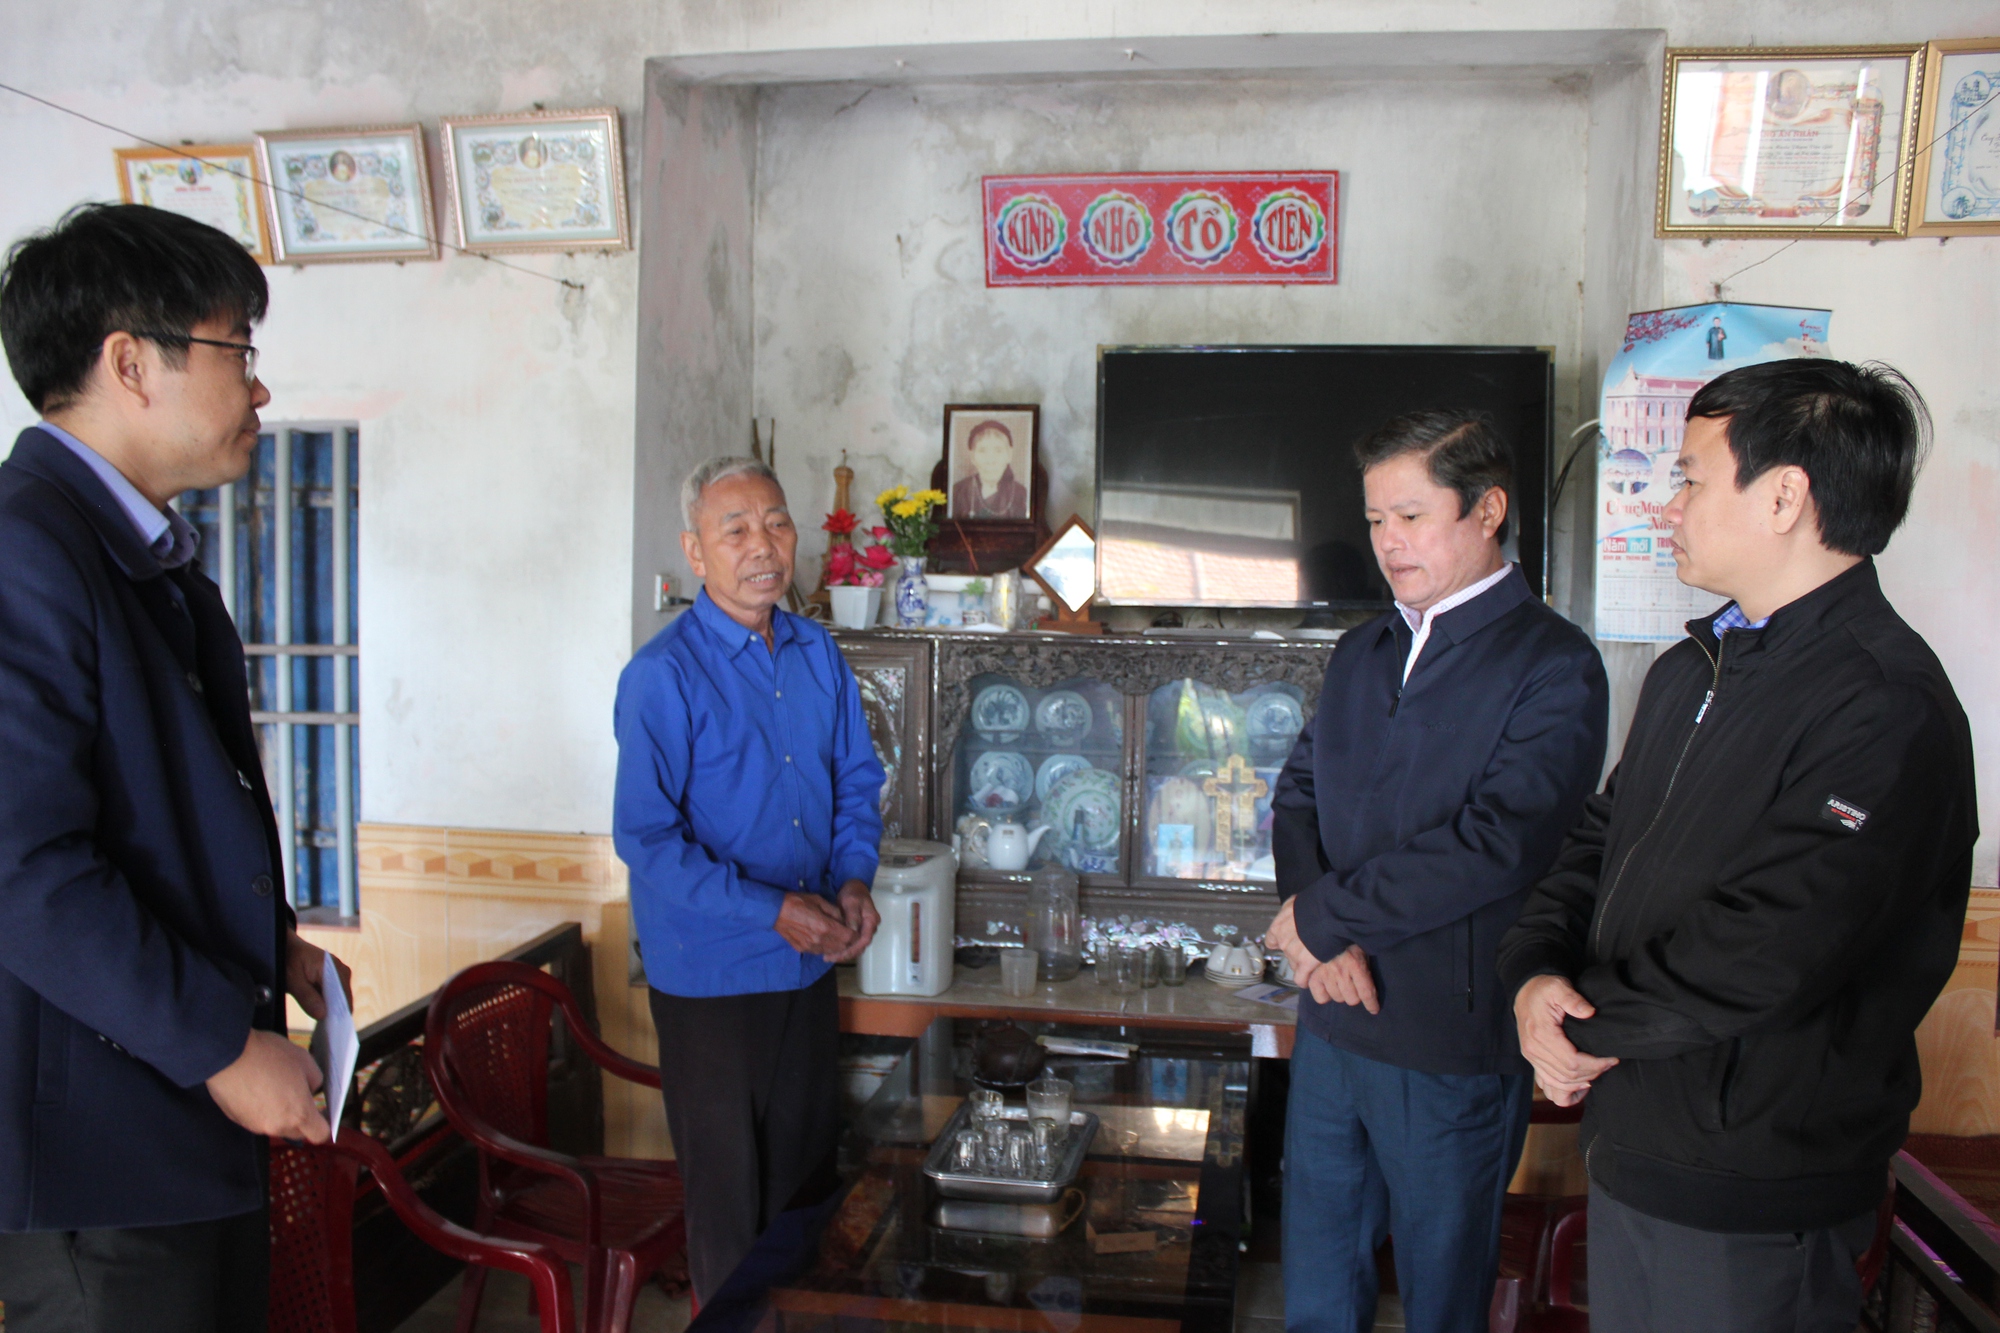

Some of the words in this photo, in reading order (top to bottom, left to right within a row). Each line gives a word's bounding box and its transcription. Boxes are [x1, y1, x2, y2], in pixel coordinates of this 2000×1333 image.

[1177, 207, 1223, 251] TỔ
[1264, 203, 1313, 252] TIÊN
[1603, 538, 1627, 552] Năm
[1631, 538, 1648, 552] mới
